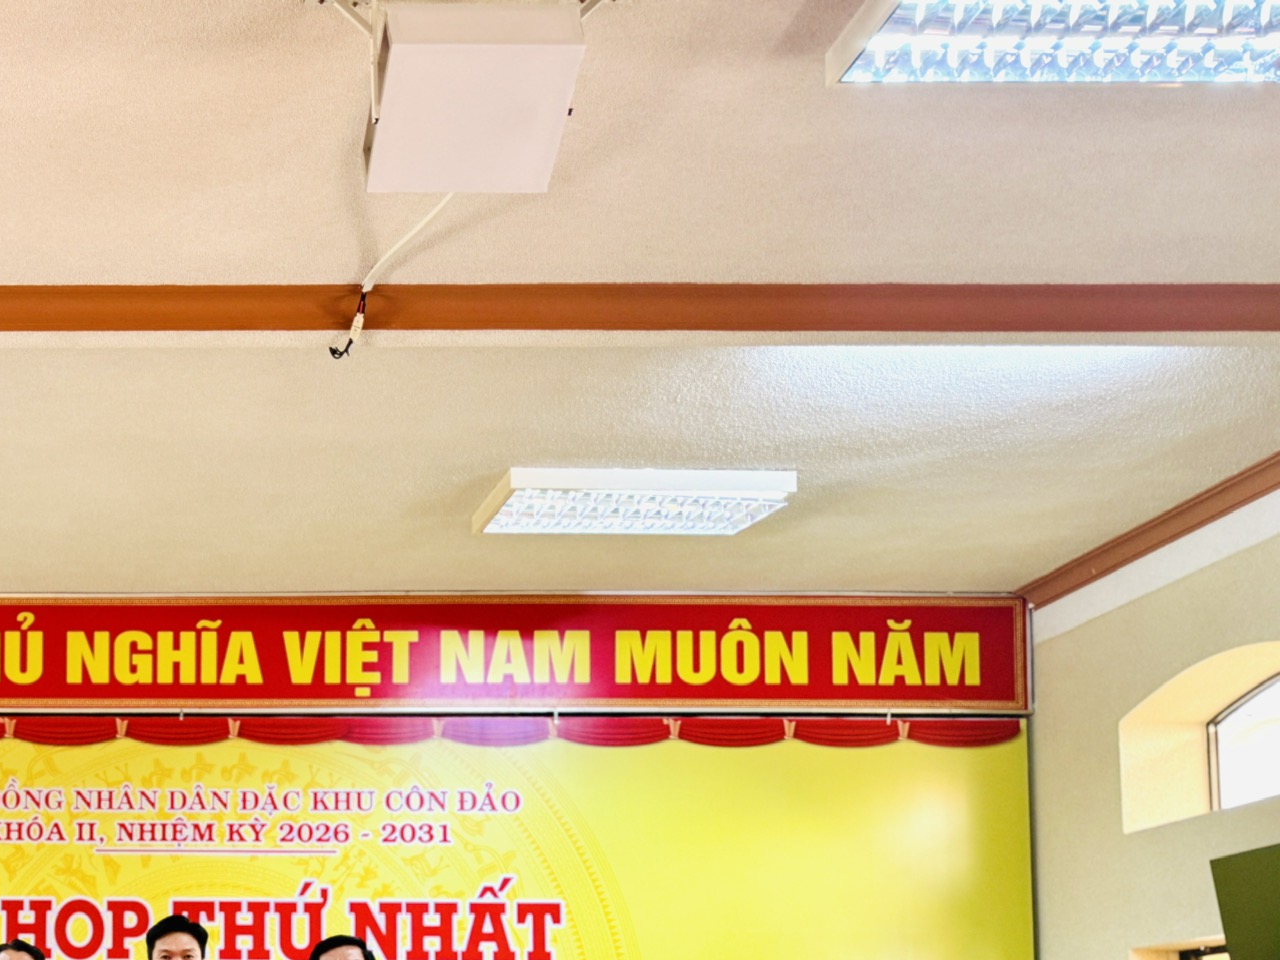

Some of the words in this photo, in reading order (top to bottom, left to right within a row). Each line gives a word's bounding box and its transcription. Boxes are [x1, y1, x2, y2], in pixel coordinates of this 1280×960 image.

[66, 619, 263, 684] NGHĨA
[283, 618, 419, 697] VIỆT
[441, 630, 591, 684] NAM
[615, 618, 809, 686] MUÔN
[832, 619, 980, 686] NĂM
[73, 784, 157, 810] NHÂN
[169, 785, 230, 811] DÂN
[240, 785, 300, 815] ĐẶC
[311, 791, 375, 811] KHU
[385, 786, 448, 811] CÔN
[458, 782, 521, 811] ĐẢO
[76, 822, 105, 843] II,
[116, 817, 215, 847] NHIỆM
[227, 817, 267, 842] KỲ
[279, 823, 350, 843] 2026
[381, 823, 452, 843] 2031
